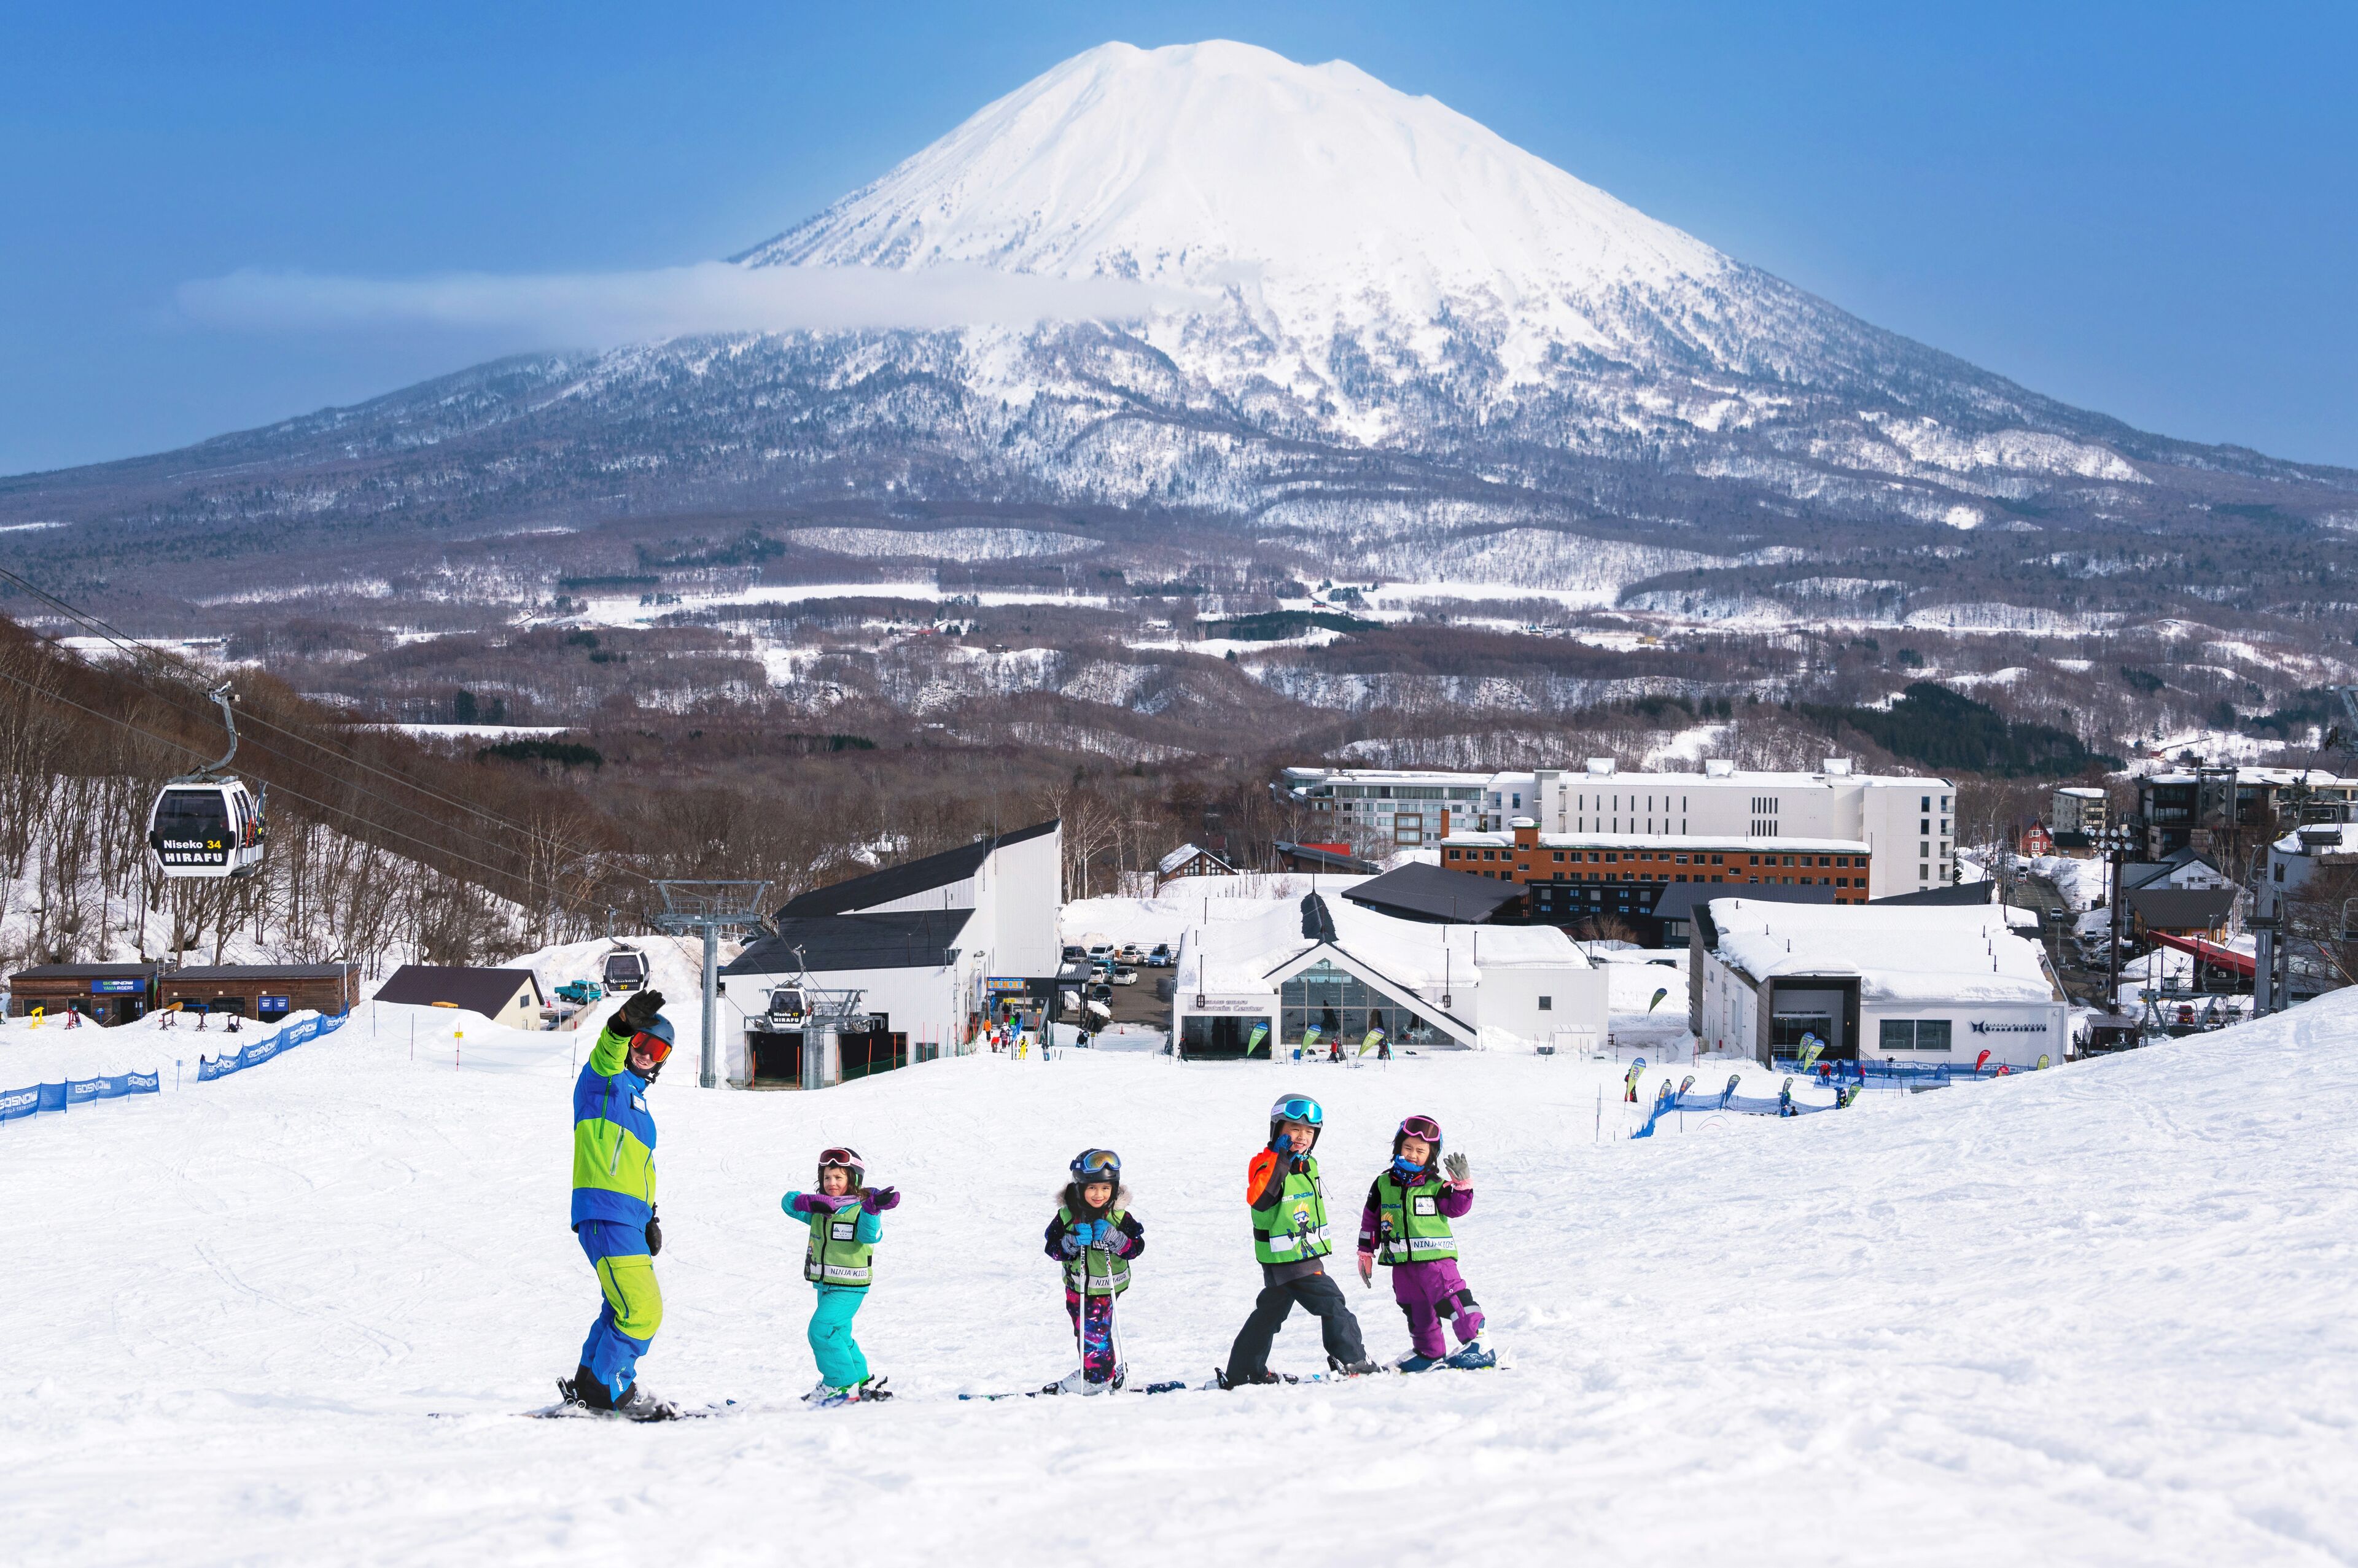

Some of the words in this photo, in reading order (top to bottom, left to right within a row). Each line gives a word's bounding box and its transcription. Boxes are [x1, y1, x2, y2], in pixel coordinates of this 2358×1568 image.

[163, 840, 203, 848] Niseko
[207, 840, 222, 848] 34
[165, 853, 222, 862] HIRAFU
[290, 1022, 317, 1040] GOSNOW
[247, 1040, 278, 1058] GOSNOW
[128, 1075, 158, 1087] GOSNOW
[75, 1080, 111, 1093] GOSNOW
[1282, 1192, 1314, 1201] GOSNOW
[830, 1268, 851, 1276] NINJA
